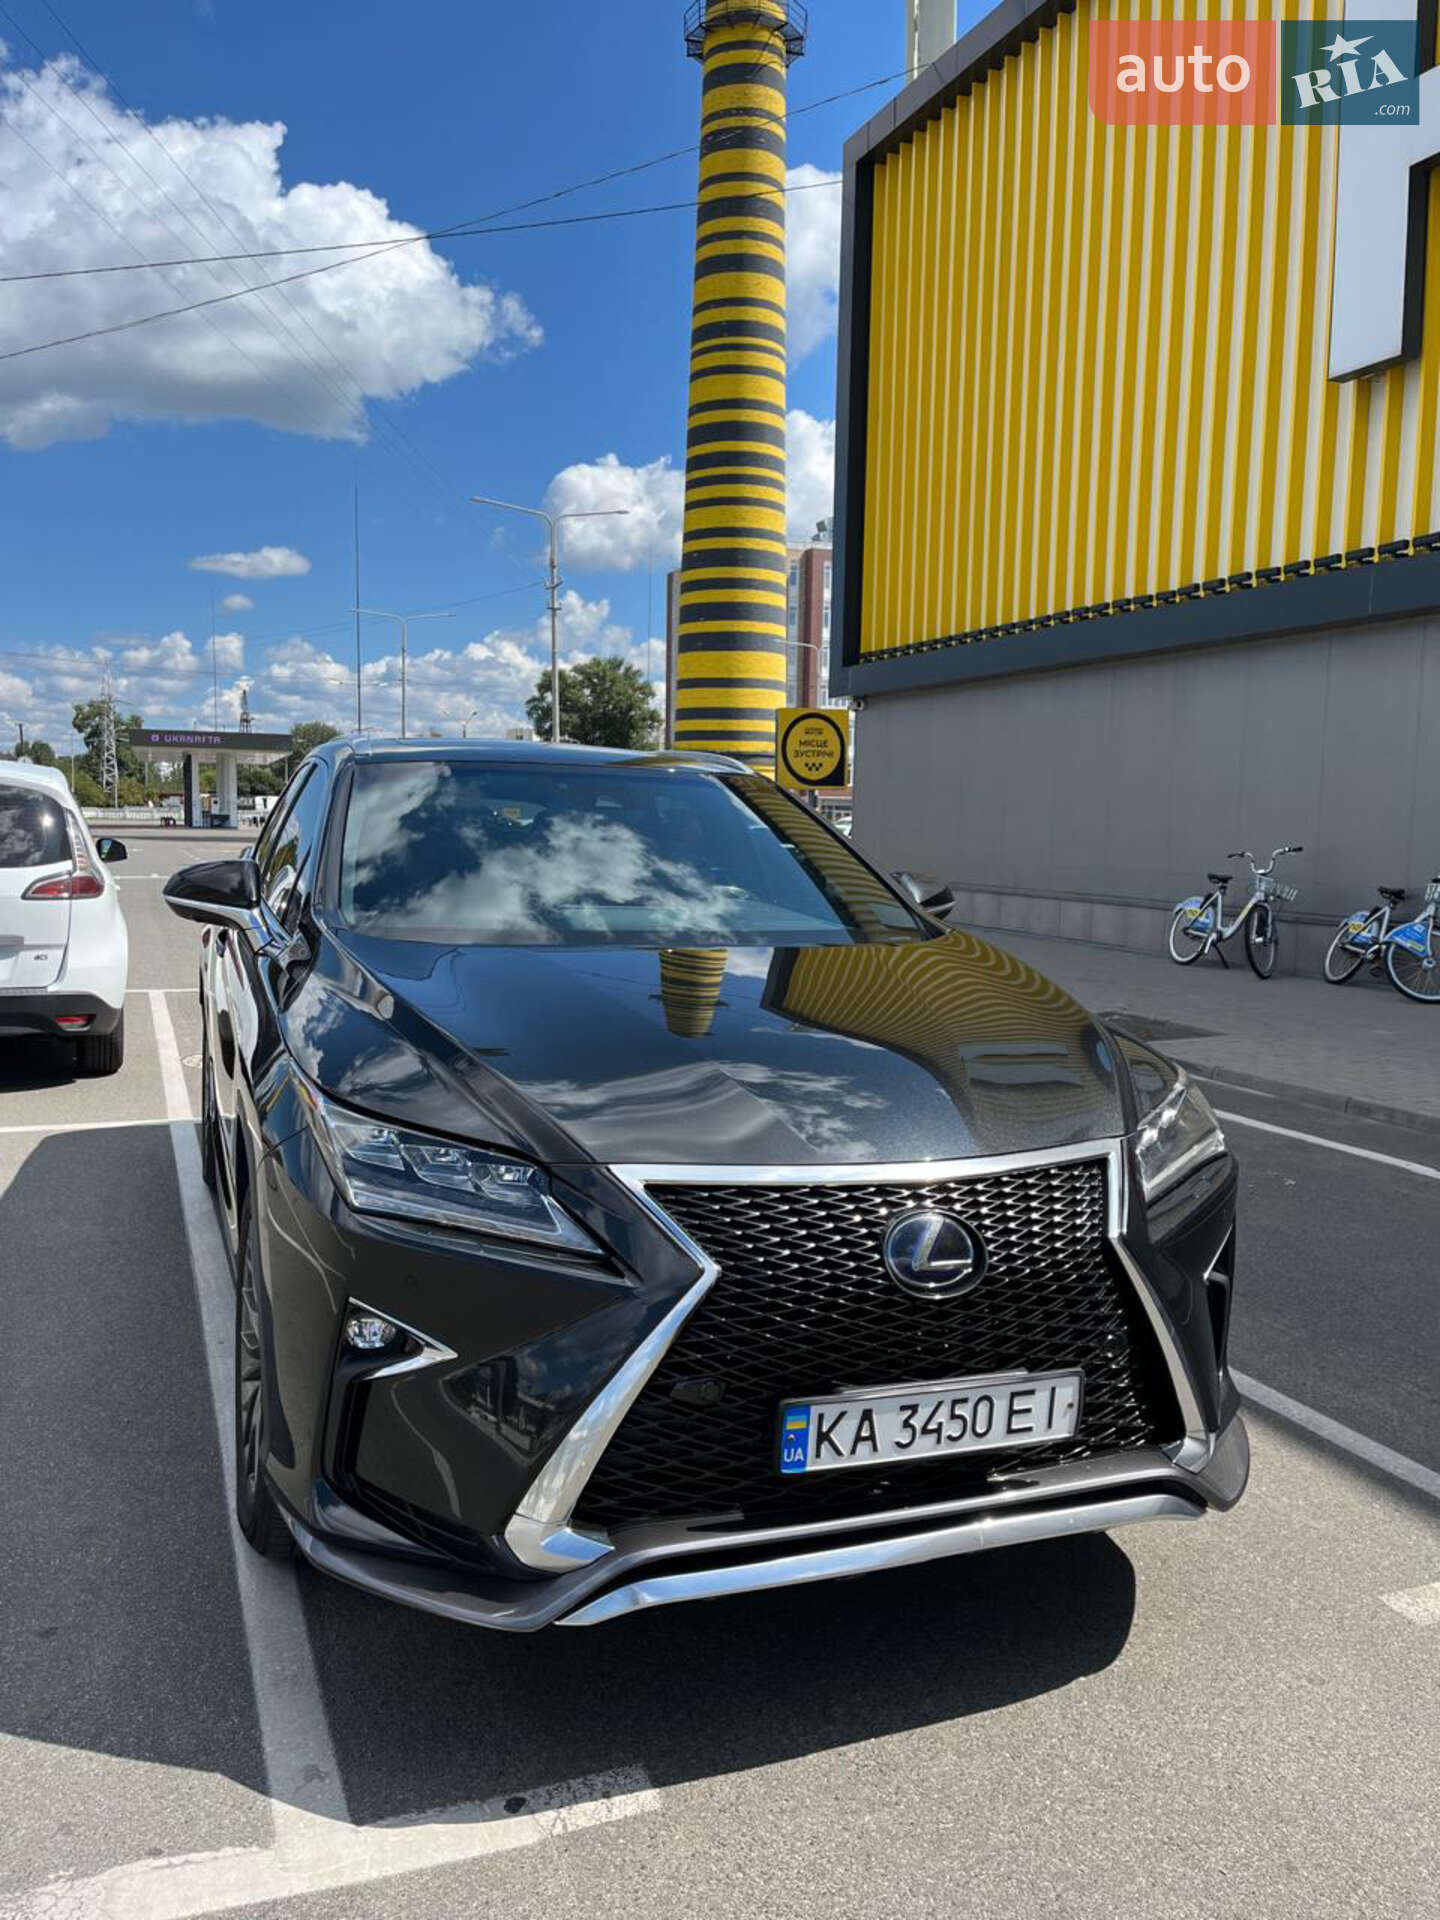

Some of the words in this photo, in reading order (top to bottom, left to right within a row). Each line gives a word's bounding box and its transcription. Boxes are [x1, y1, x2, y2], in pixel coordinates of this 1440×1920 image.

[799, 740, 828, 748] МІСЦЕ
[815, 1408, 879, 1459] KA
[894, 1394, 995, 1450] 3450
[783, 1447, 805, 1463] UA
